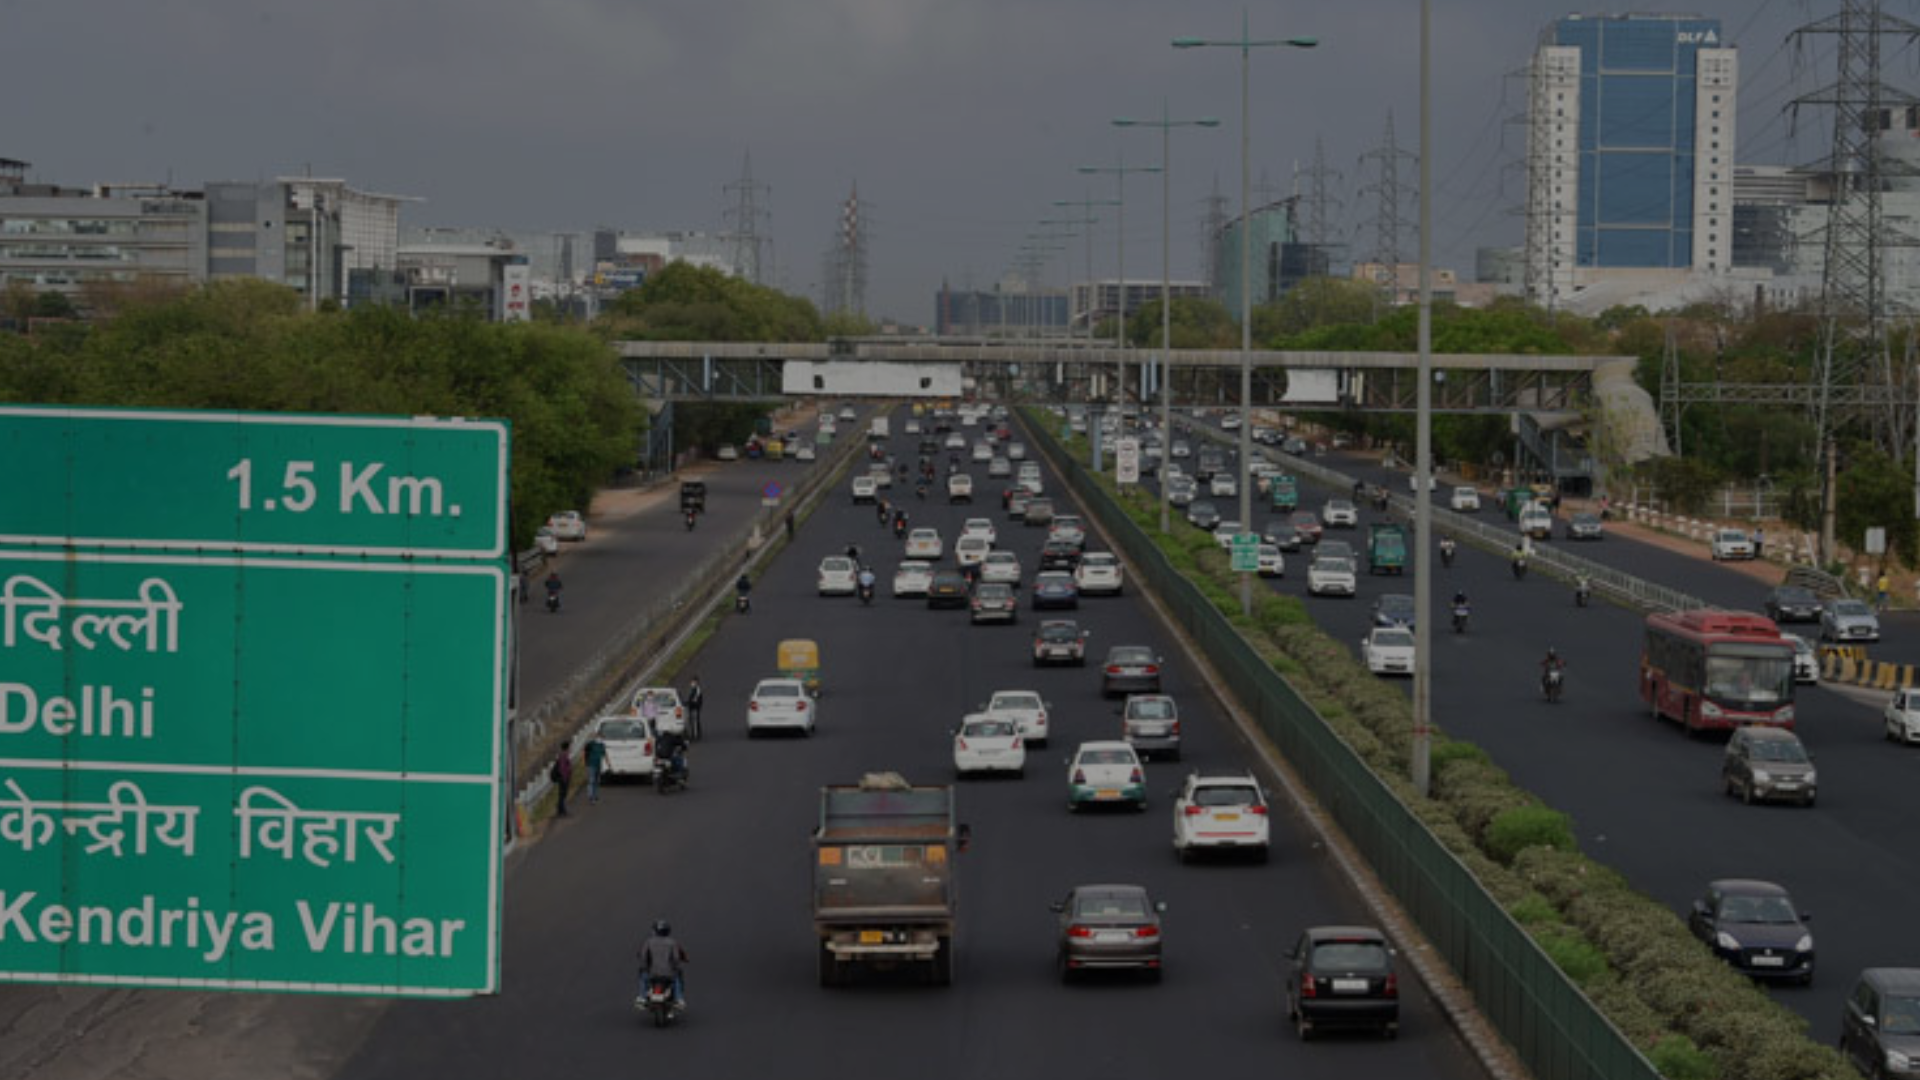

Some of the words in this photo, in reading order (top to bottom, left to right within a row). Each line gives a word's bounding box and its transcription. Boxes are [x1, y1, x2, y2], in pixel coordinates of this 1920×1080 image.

[228, 458, 317, 512] 1.5
[340, 461, 461, 516] Km.
[0, 575, 183, 652] दिल्ली
[0, 682, 154, 738] Delhi
[0, 778, 200, 857] केन्द्रीय
[233, 785, 401, 868] विहार
[0, 889, 274, 962] Kendriya
[296, 900, 466, 957] Vihar
